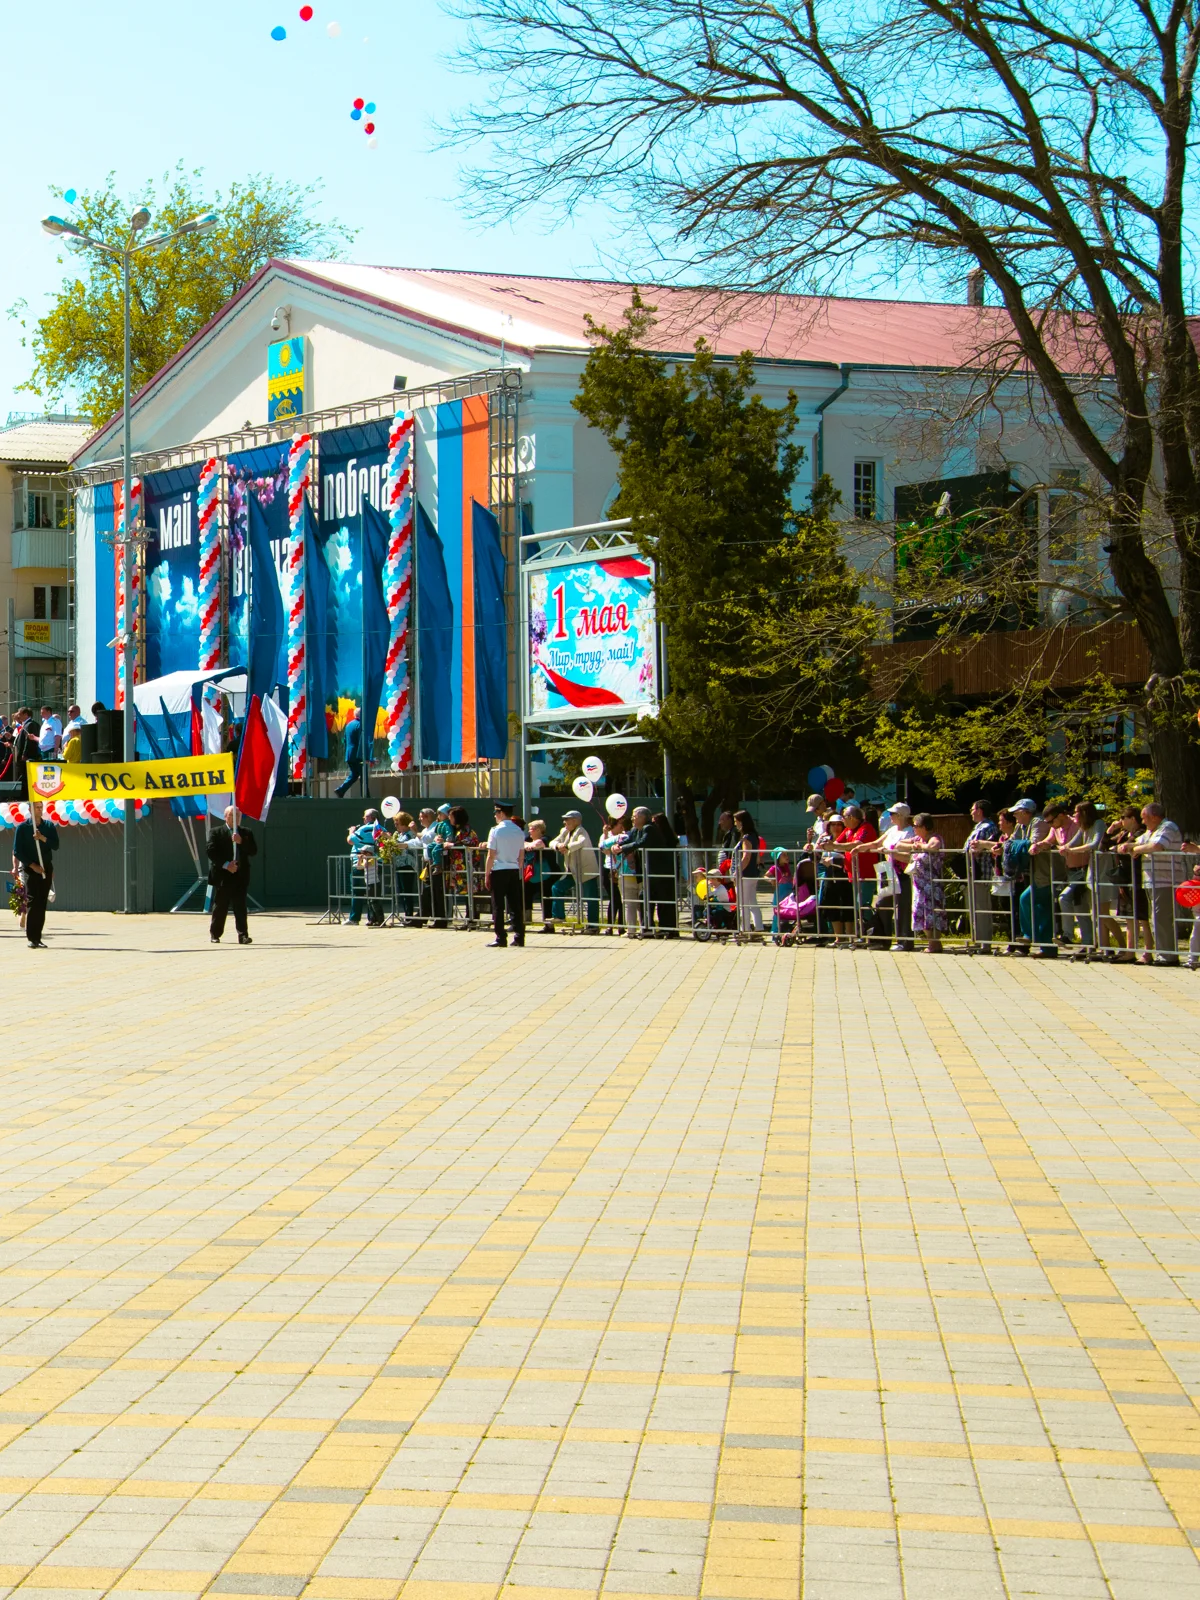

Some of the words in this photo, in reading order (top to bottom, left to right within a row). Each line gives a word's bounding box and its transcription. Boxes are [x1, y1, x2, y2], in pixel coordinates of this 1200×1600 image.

[324, 459, 391, 521] победа
[159, 492, 192, 550] май
[233, 537, 290, 597] вена
[553, 585, 567, 638] 1
[577, 603, 630, 637] мая
[548, 650, 574, 672] Мир,
[575, 650, 604, 671] труд,
[606, 642, 634, 660] май!
[86, 773, 135, 791] ТОС
[144, 770, 226, 790] Анапы
